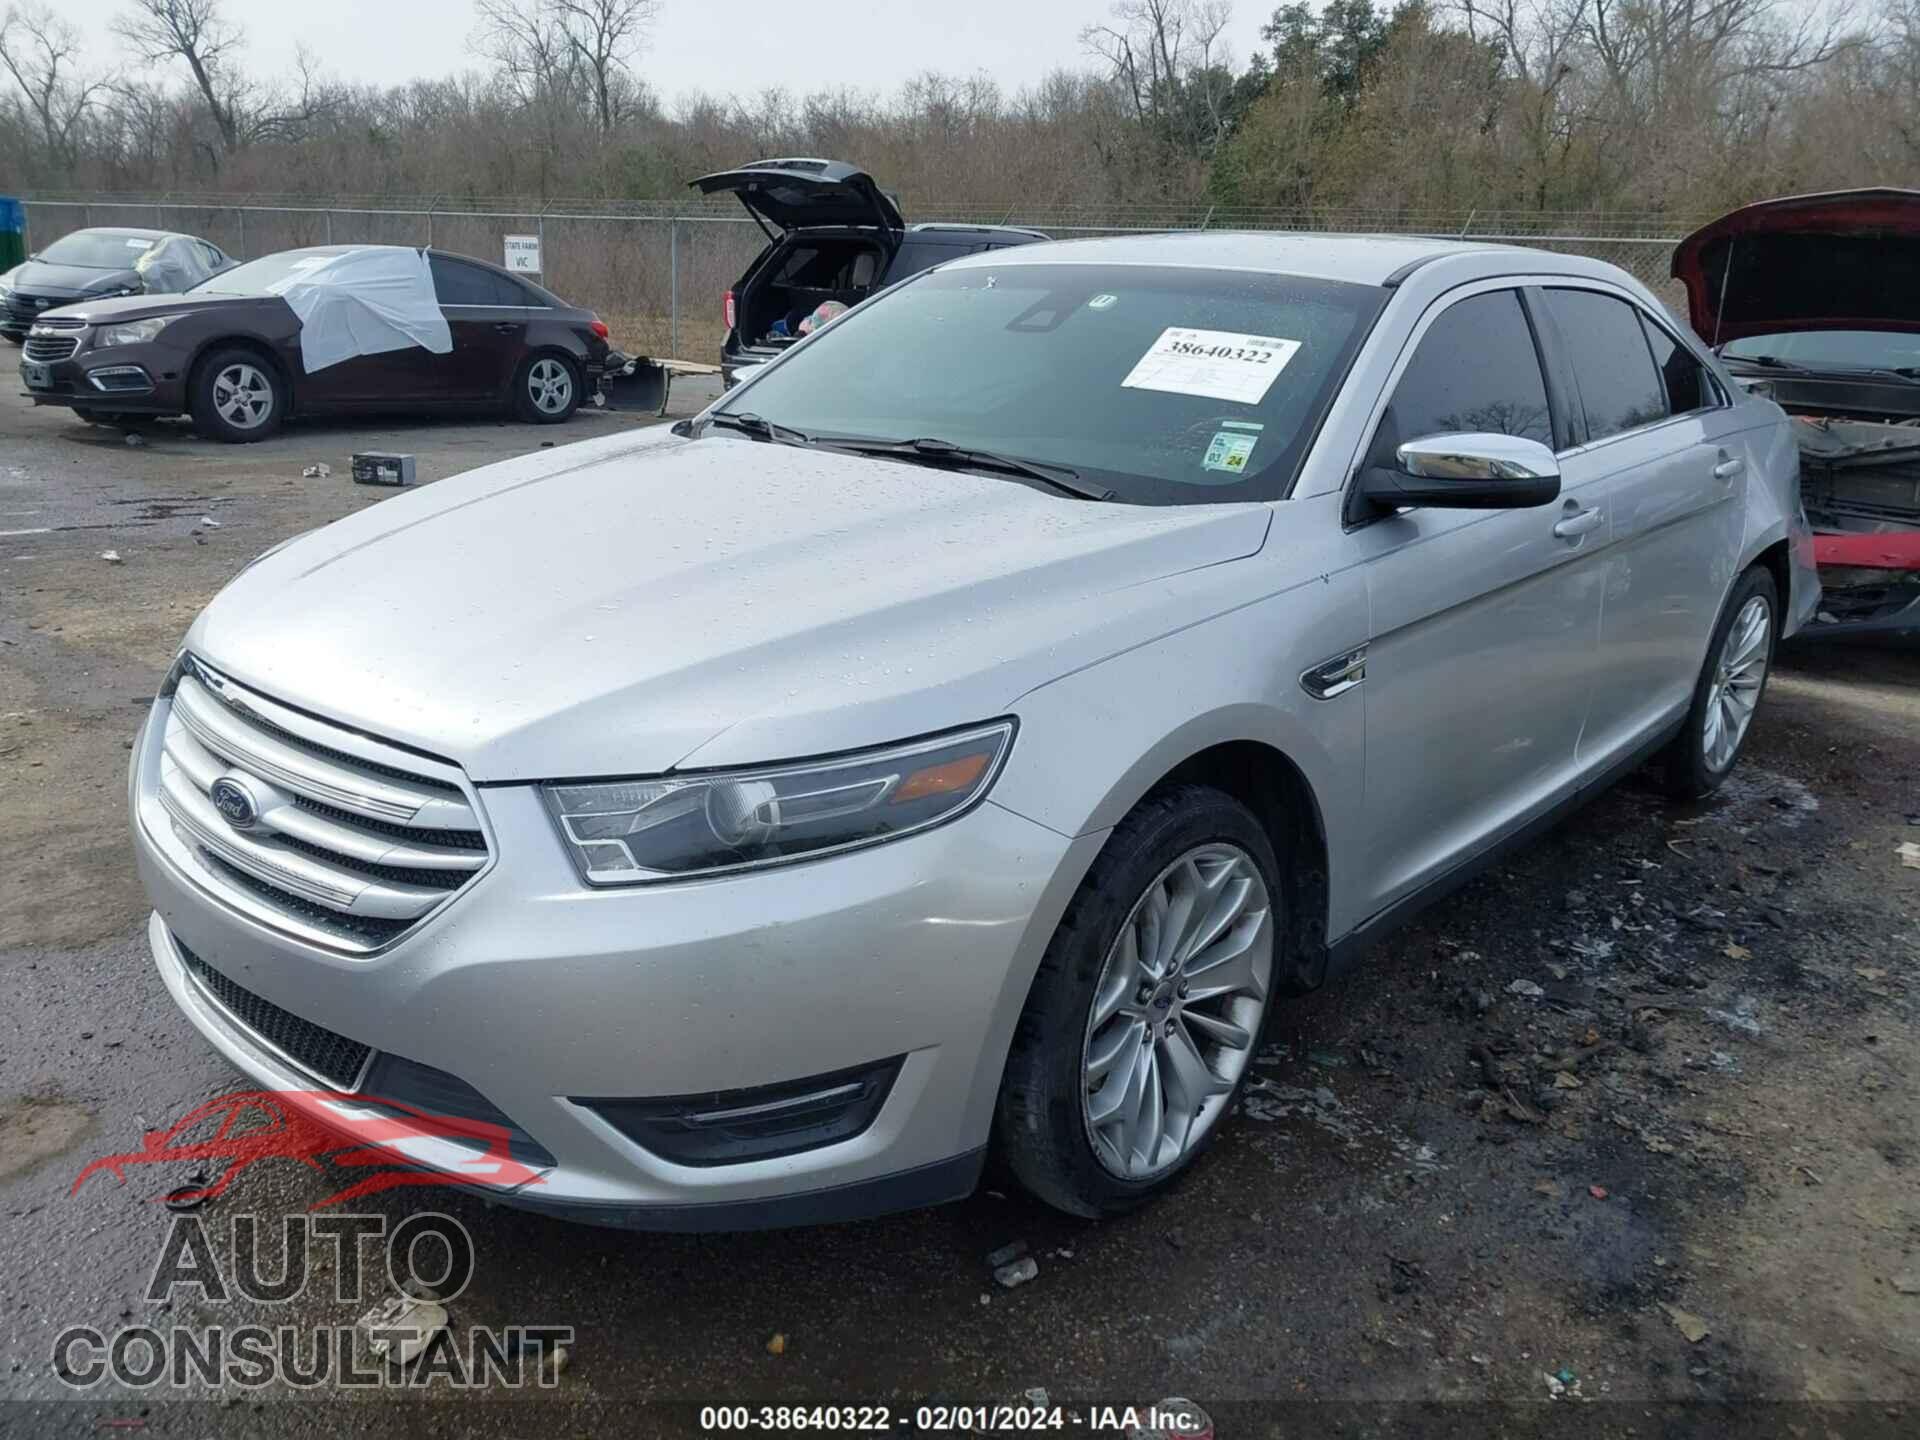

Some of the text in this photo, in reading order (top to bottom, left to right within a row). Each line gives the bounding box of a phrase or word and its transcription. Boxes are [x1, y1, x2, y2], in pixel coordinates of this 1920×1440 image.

[515, 255, 529, 267] VIC
[1164, 340, 1273, 365] 38640322
[1227, 455, 1243, 467] 24
